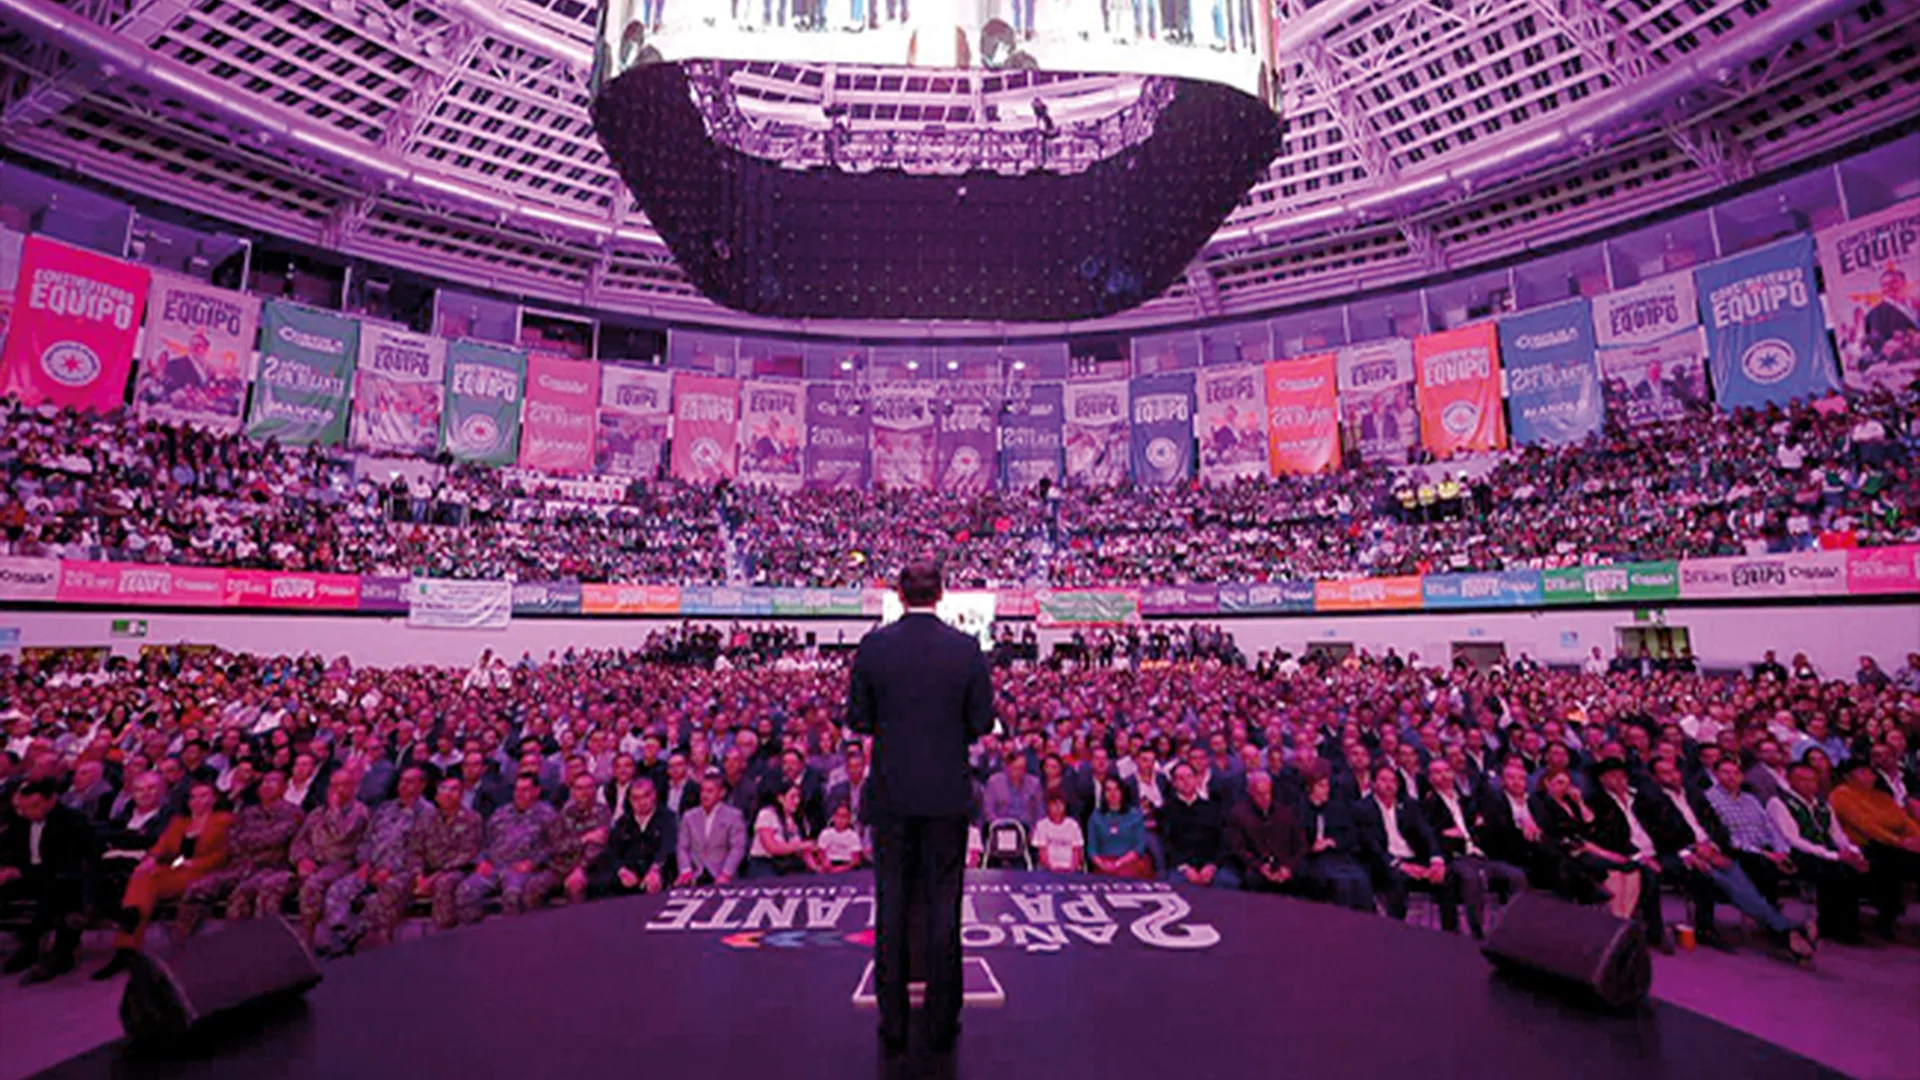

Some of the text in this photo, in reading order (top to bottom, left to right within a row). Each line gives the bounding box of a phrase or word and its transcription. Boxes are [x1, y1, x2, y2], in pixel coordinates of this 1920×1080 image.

[1839, 230, 1917, 275] EQUIP
[29, 283, 133, 330] EQUIPO
[163, 301, 241, 337] EQUIPO
[1611, 304, 1679, 336] EQUIPO
[1713, 280, 1808, 328] EQUIPO
[452, 374, 517, 402] EQUIPO
[1424, 359, 1490, 387] EQUIPO
[961, 893, 1221, 951] 2 AÑO
